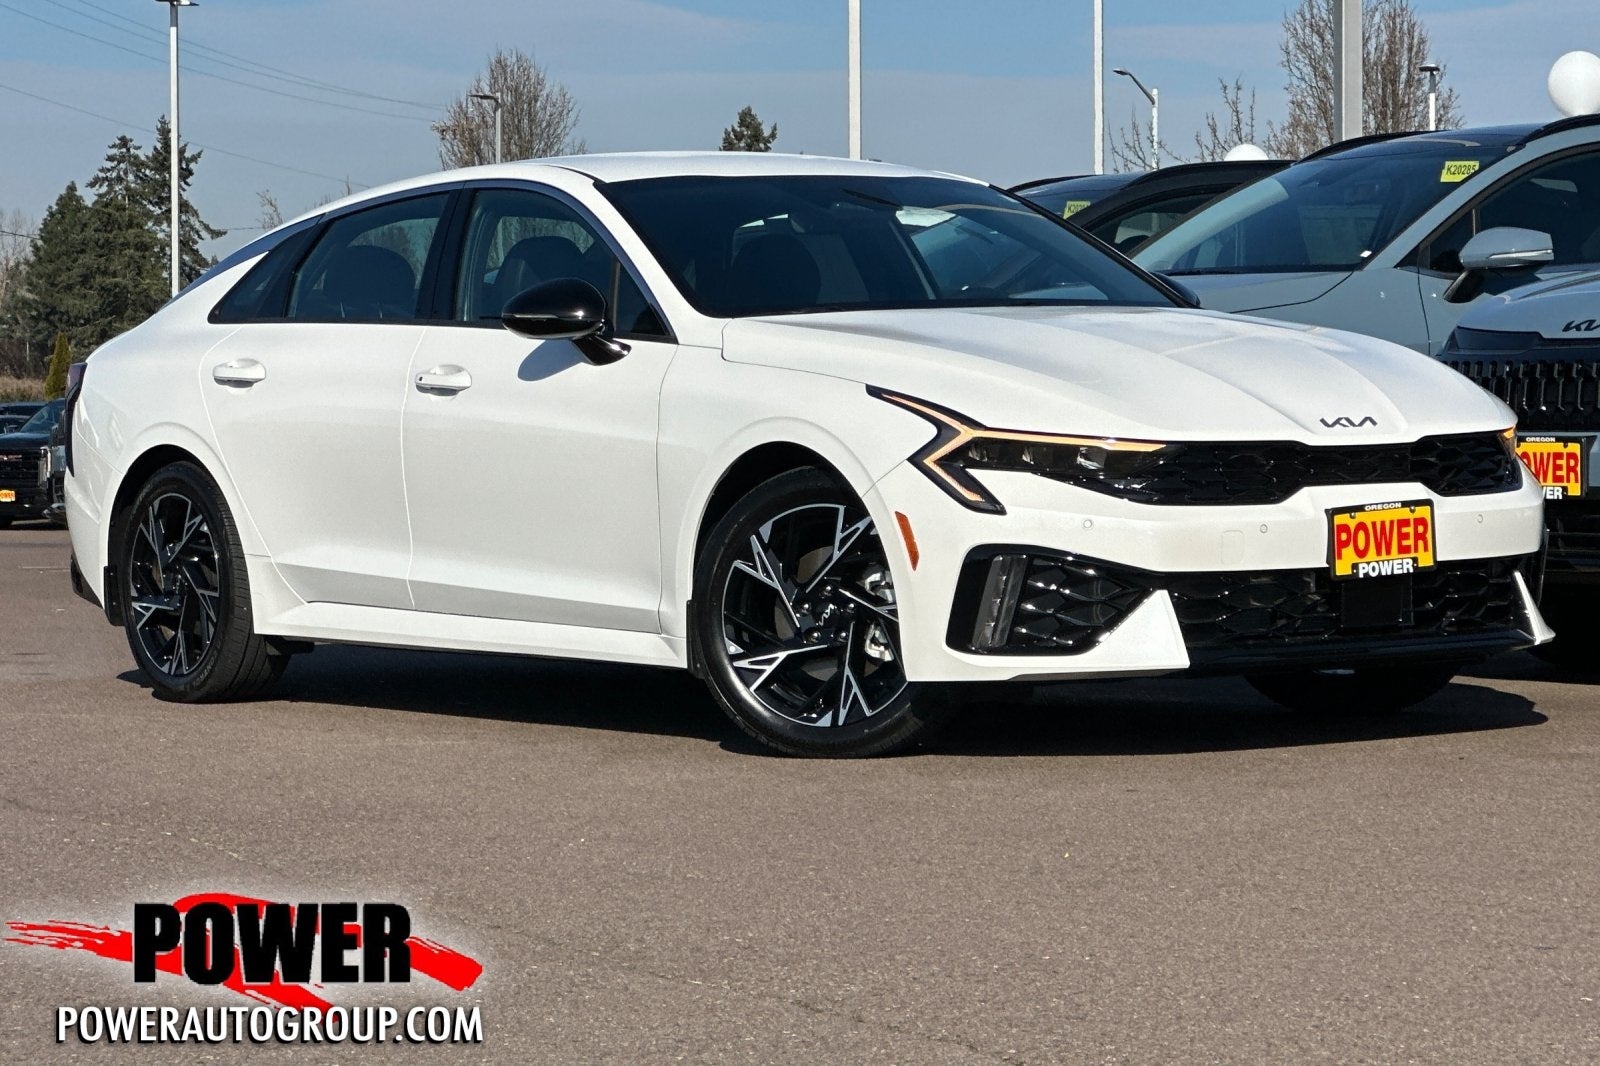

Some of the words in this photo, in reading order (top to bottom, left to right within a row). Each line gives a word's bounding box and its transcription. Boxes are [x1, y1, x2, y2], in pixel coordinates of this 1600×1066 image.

[1446, 164, 1476, 176] K20285
[1319, 416, 1378, 428] KIA
[1364, 502, 1402, 512] OREGON
[1335, 516, 1430, 561] POWER
[1358, 558, 1414, 579] POWER
